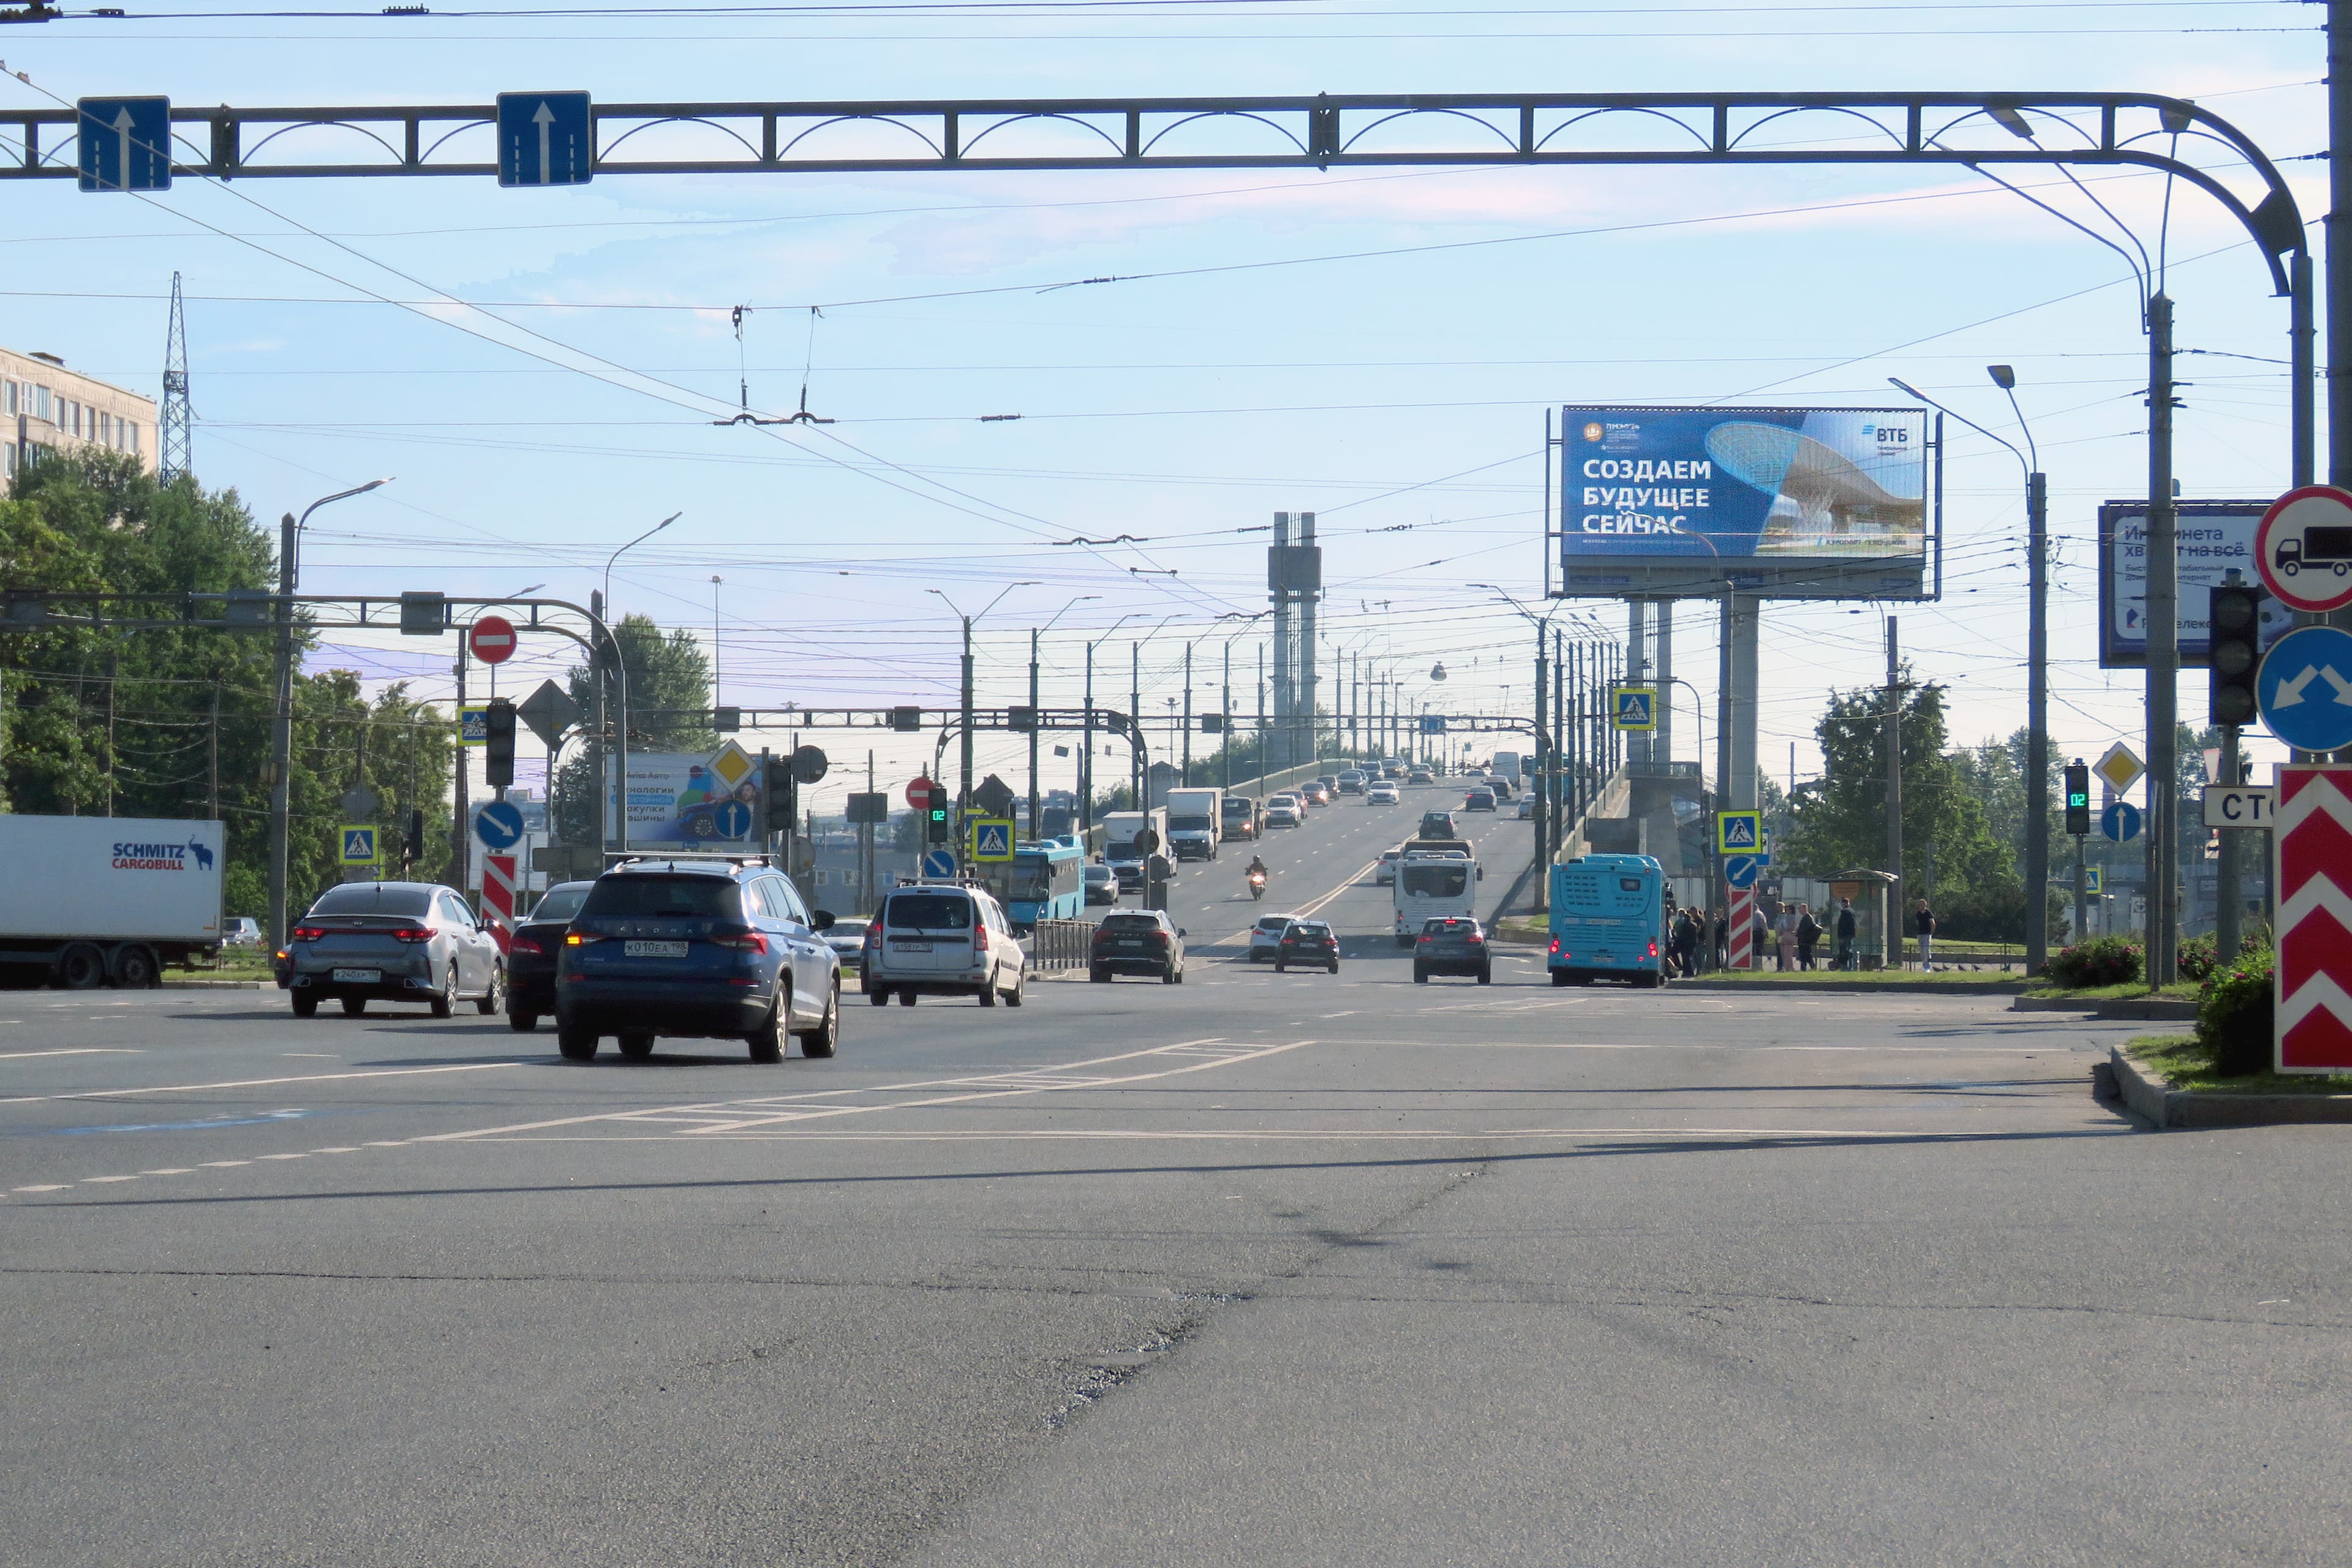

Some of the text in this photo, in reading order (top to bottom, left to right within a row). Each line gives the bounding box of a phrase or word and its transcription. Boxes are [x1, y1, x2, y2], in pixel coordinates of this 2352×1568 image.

[1877, 428, 1907, 442] ВТБ
[1583, 459, 1711, 483] СОЗДАЕМ
[1583, 487, 1710, 510] БУДУЩЕЕ
[1583, 510, 1686, 534] СЕЙЧАС
[2188, 546, 2209, 557] на
[2214, 541, 2245, 557] всё
[2071, 794, 2084, 806] 02
[2222, 794, 2274, 820] СТ
[933, 810, 944, 821] 02
[113, 843, 185, 858] SCHMITZ
[112, 858, 184, 870] CARGOBULL
